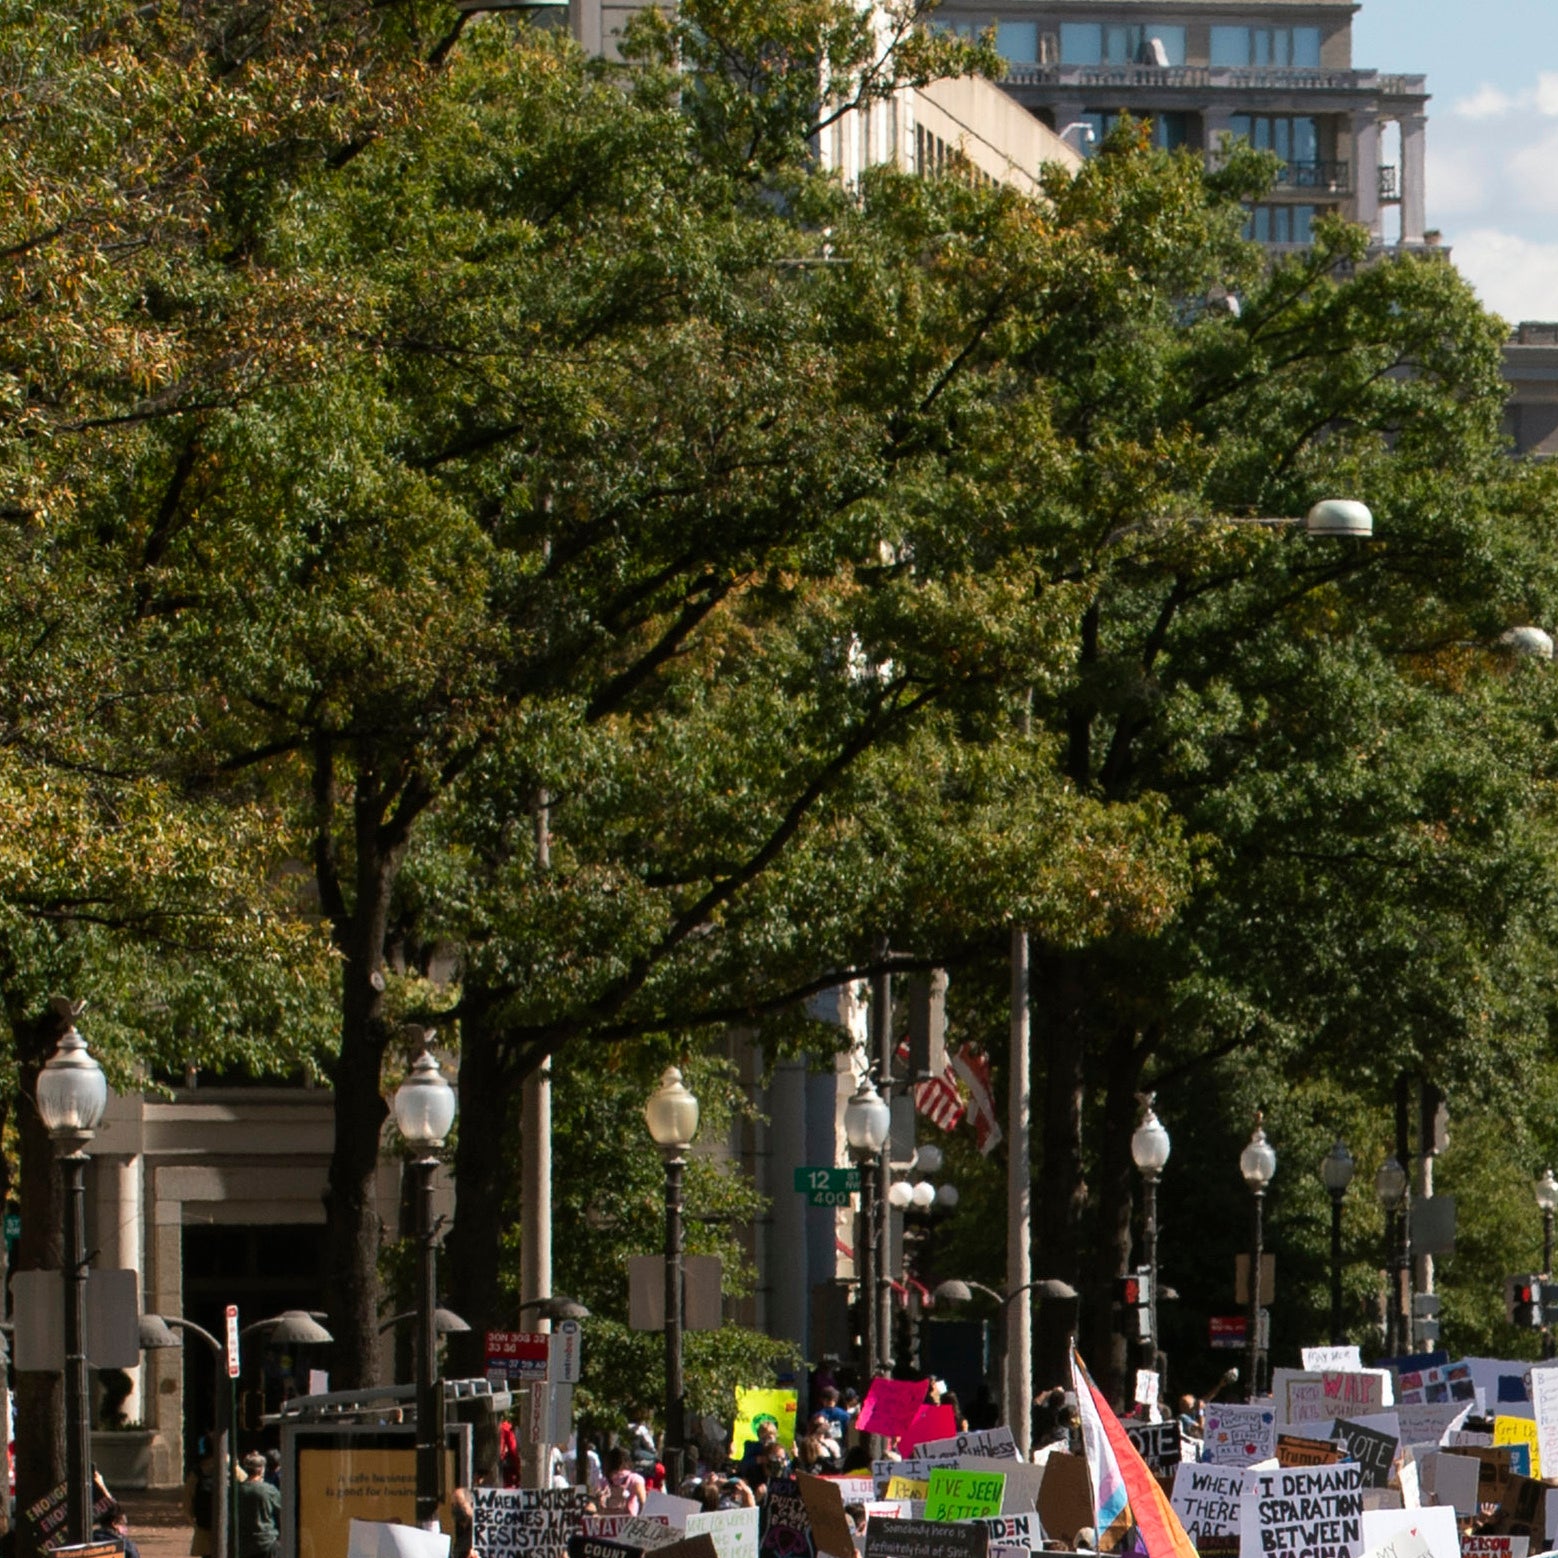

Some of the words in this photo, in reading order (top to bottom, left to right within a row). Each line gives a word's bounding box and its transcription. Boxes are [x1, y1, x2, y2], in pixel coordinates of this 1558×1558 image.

[1260, 1477, 1274, 1497] I
[1283, 1469, 1361, 1496] DEMAND
[475, 1489, 521, 1510] WHEN
[524, 1487, 588, 1509] INJUSTICE
[1259, 1494, 1362, 1524] SEPARATION
[475, 1511, 544, 1526] BECOMES
[548, 1510, 583, 1527] LAW
[474, 1526, 583, 1548] RESISTANCE
[1261, 1520, 1359, 1551] BETWEEN
